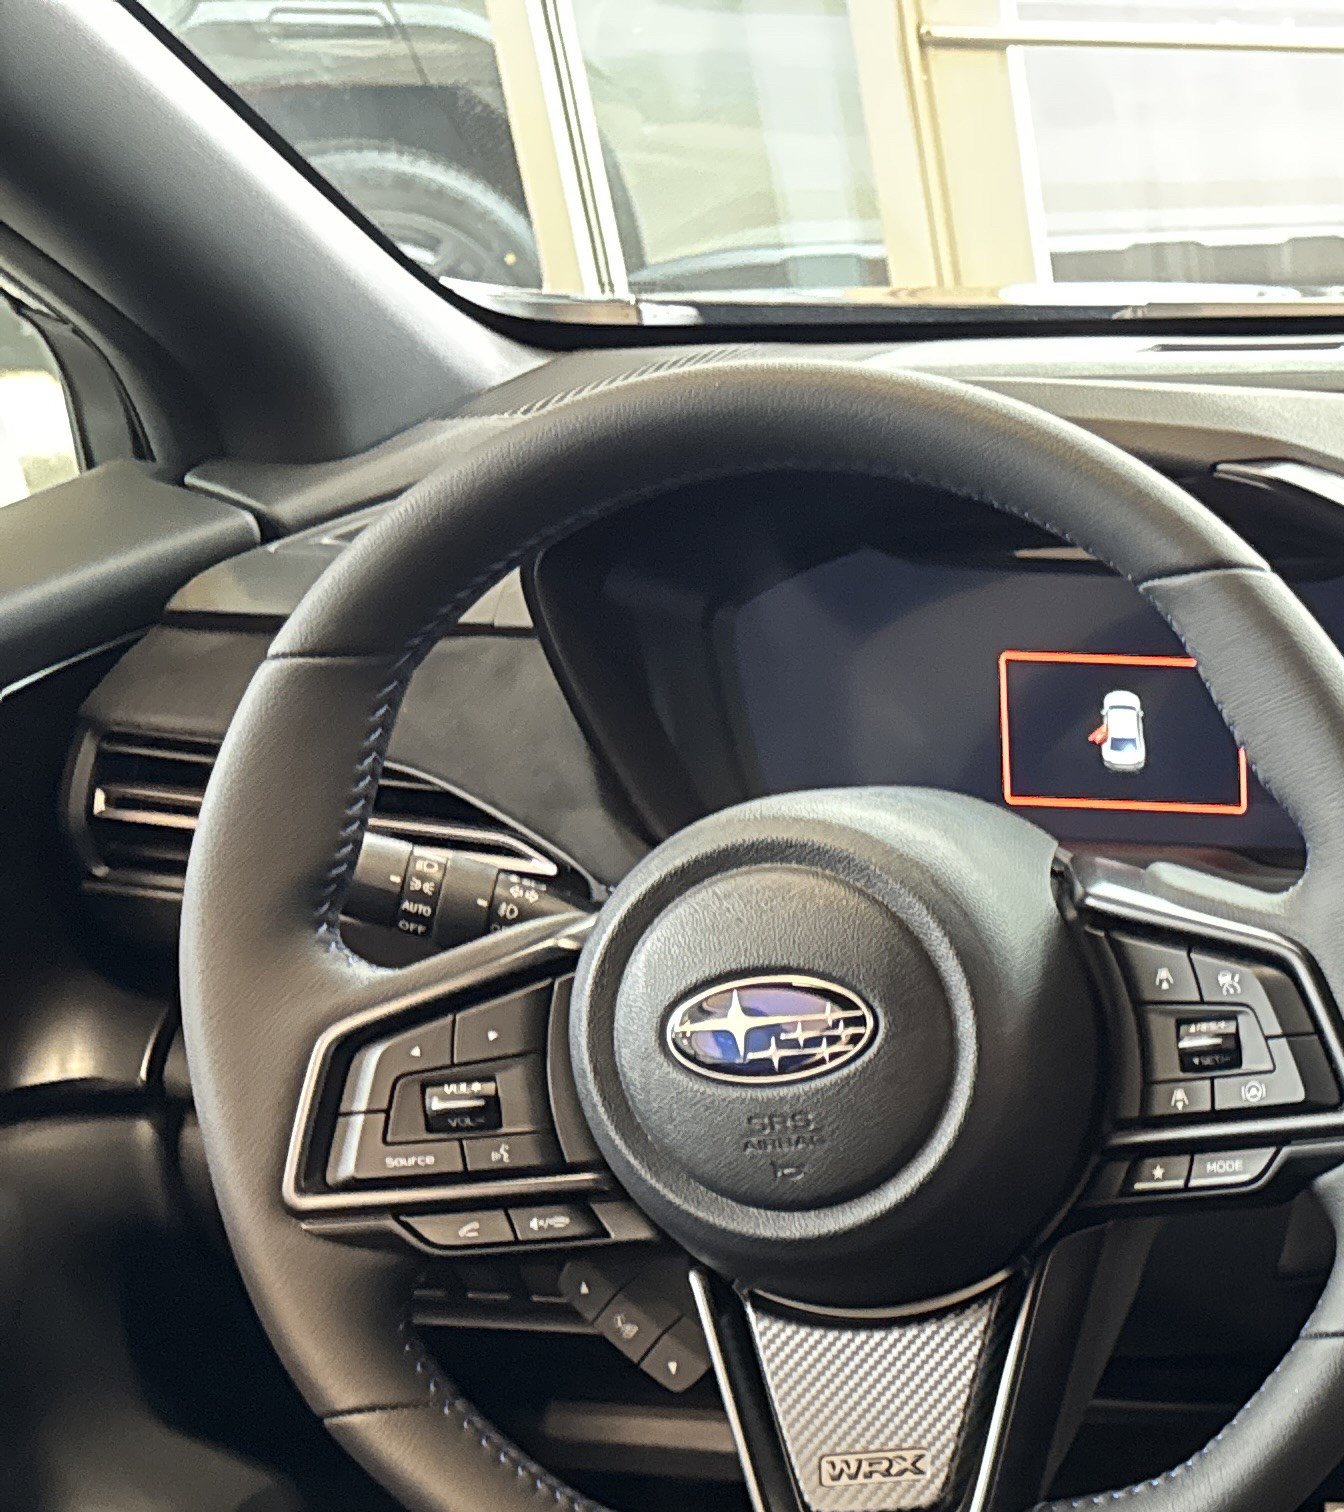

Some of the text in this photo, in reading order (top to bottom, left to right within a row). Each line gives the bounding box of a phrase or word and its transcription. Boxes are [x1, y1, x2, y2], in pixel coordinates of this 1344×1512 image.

[401, 900, 432, 917] AUTO
[398, 920, 426, 935] OFF
[1206, 1160, 1244, 1174] MODE
[826, 1454, 926, 1482] WRX
